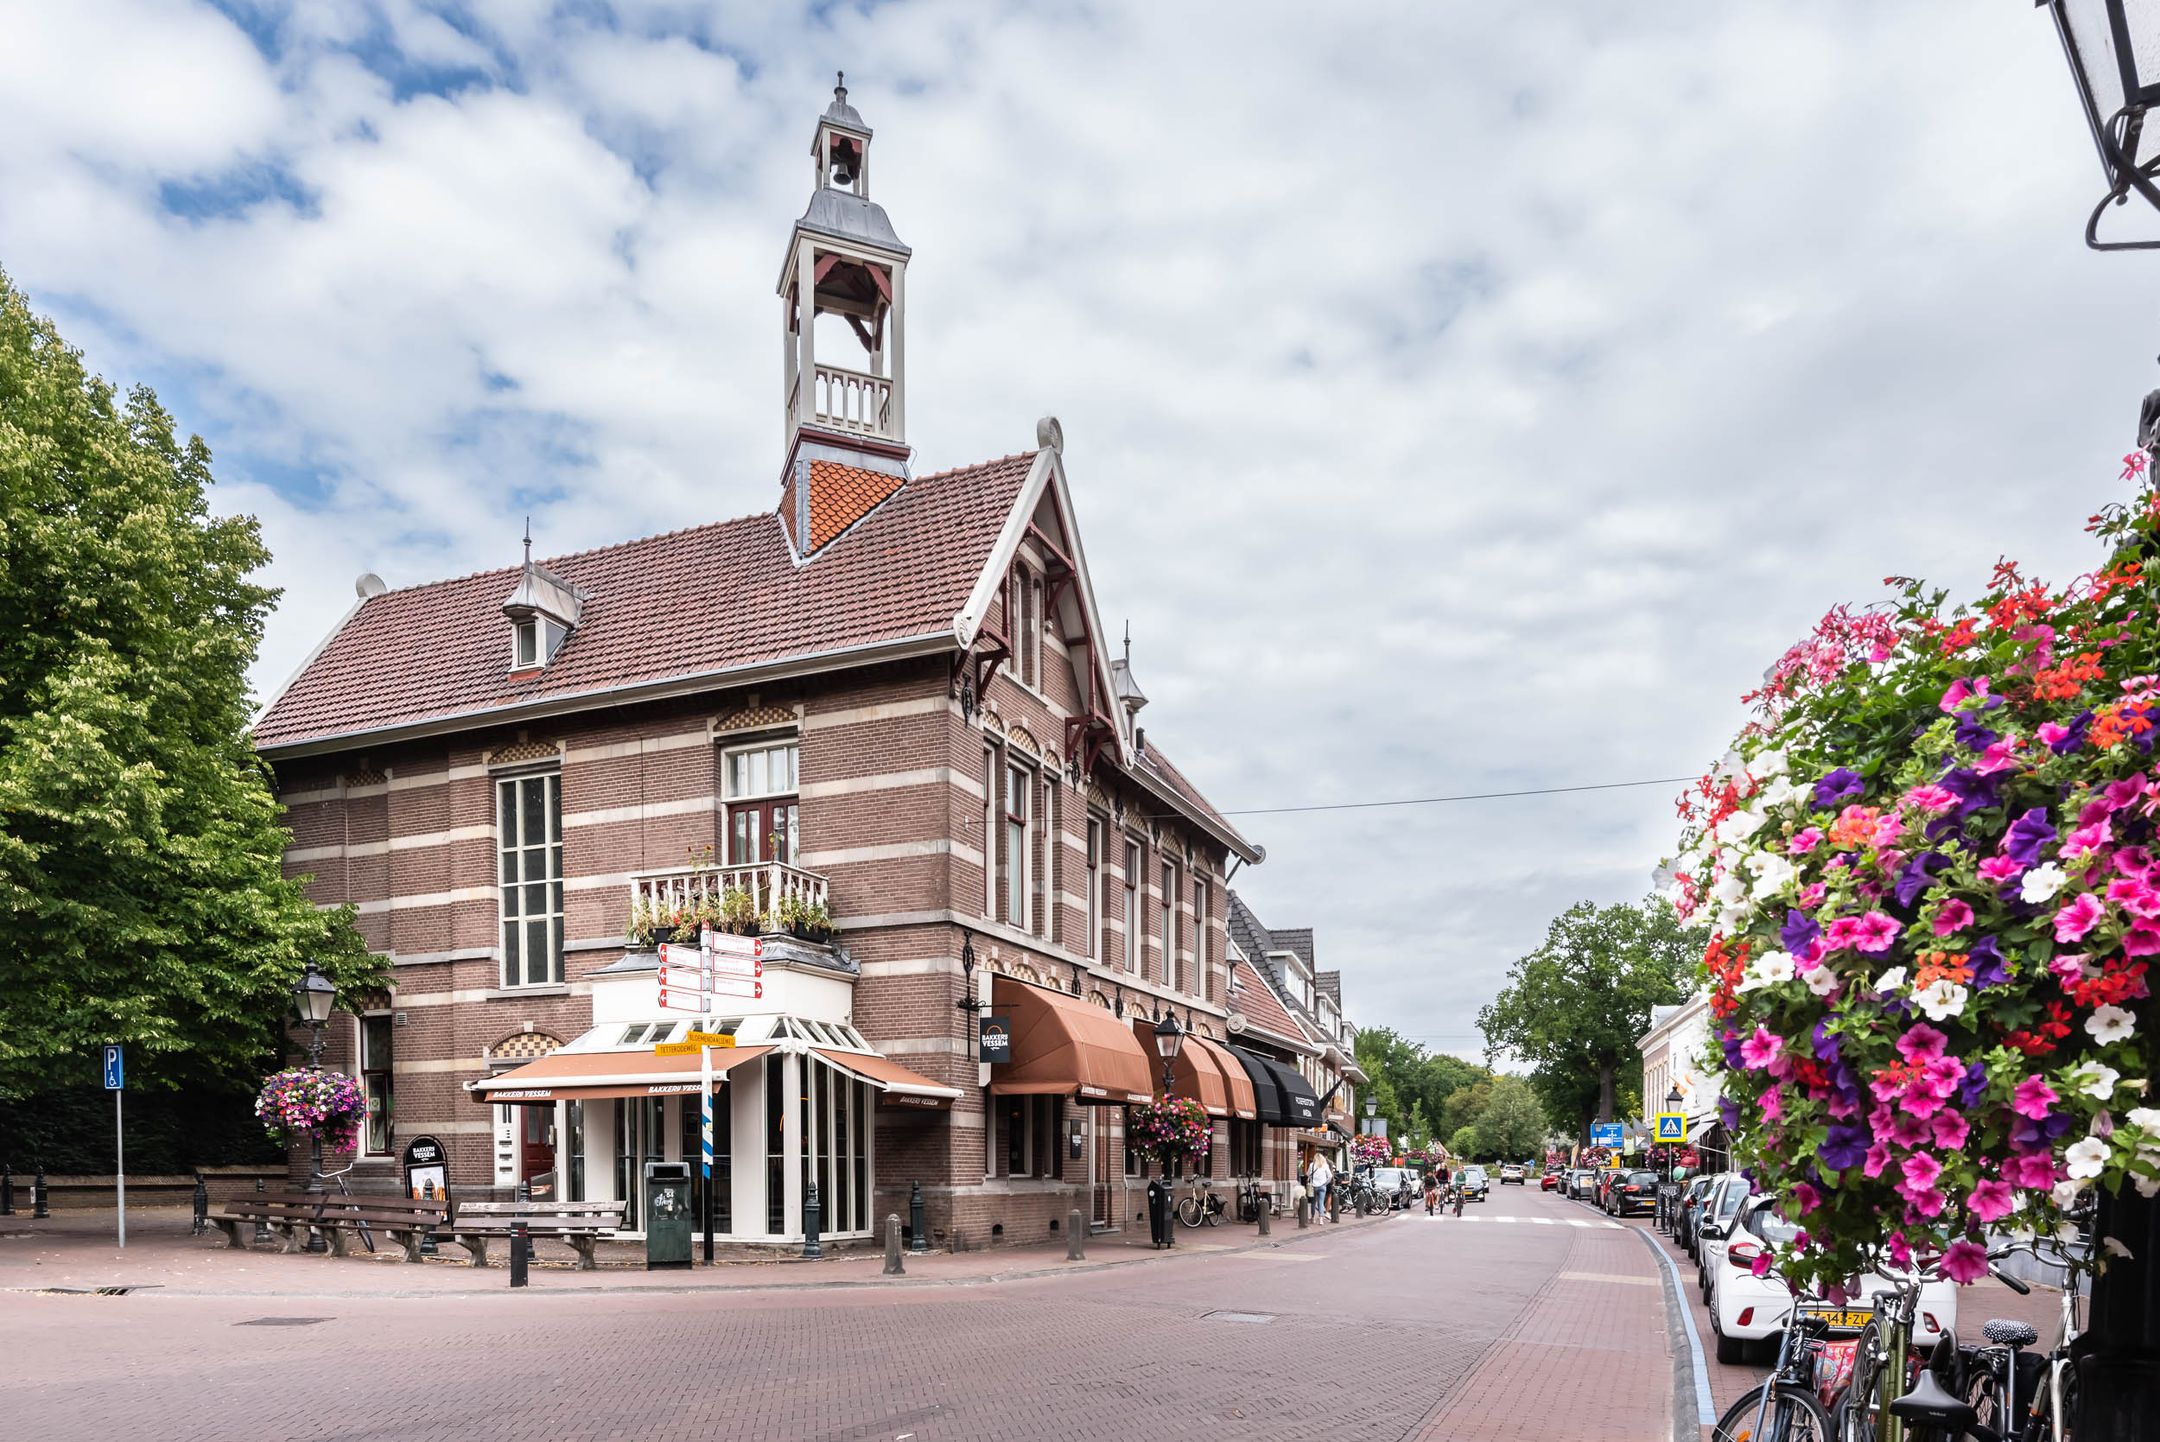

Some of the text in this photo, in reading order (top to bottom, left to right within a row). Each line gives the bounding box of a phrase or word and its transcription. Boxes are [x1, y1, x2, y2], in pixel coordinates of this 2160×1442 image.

[660, 1044, 697, 1054] TETTERODEWEG
[107, 1048, 117, 1070] P
[524, 1089, 552, 1097] VESSEM
[682, 1084, 702, 1092] VESS
[1813, 1312, 1866, 1325] -14-ZL
